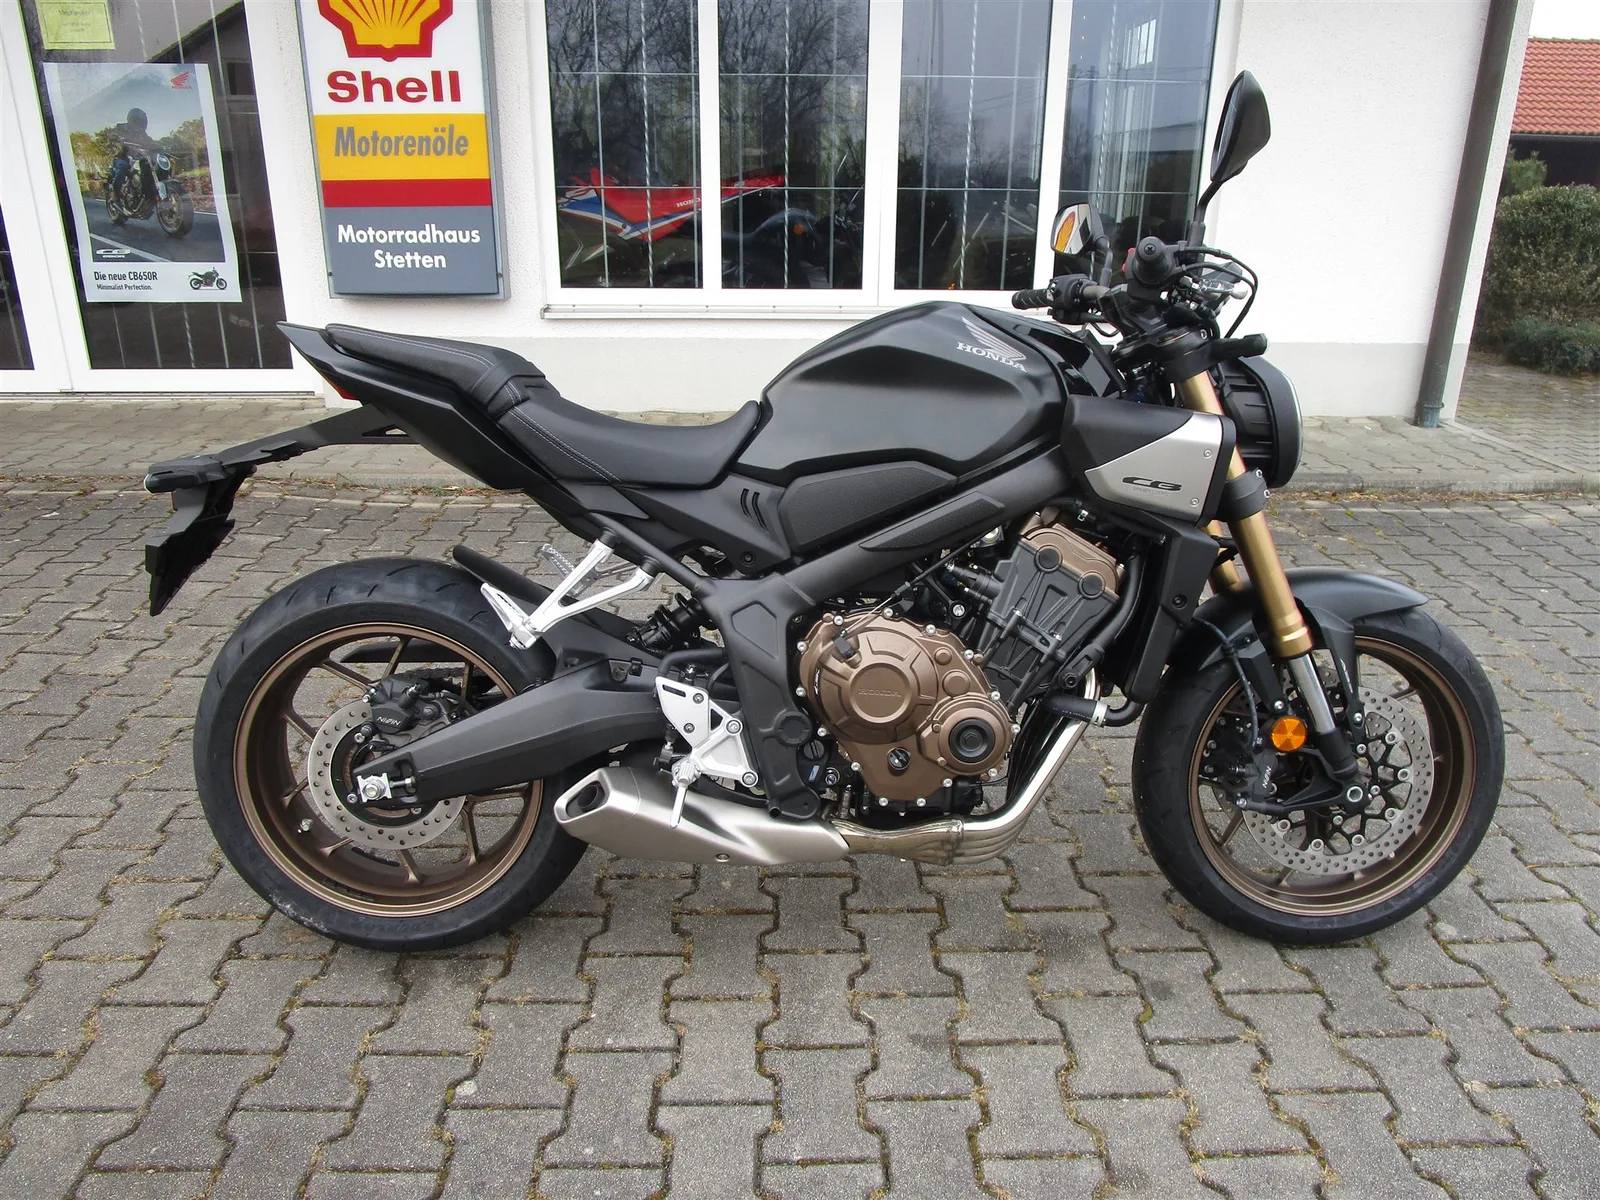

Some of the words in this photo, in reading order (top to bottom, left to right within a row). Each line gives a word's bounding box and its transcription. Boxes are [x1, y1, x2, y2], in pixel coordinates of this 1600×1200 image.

[327, 70, 461, 103] Shell
[334, 124, 469, 157] Motorenöle
[337, 224, 481, 244] Motorradhaus
[373, 249, 447, 268] Stetten
[94, 271, 107, 281] Die
[108, 273, 127, 281] neue
[128, 271, 158, 281] CB650R
[956, 341, 1028, 373] HONDA
[1122, 476, 1182, 491] CB
[858, 688, 903, 697] HONDA
